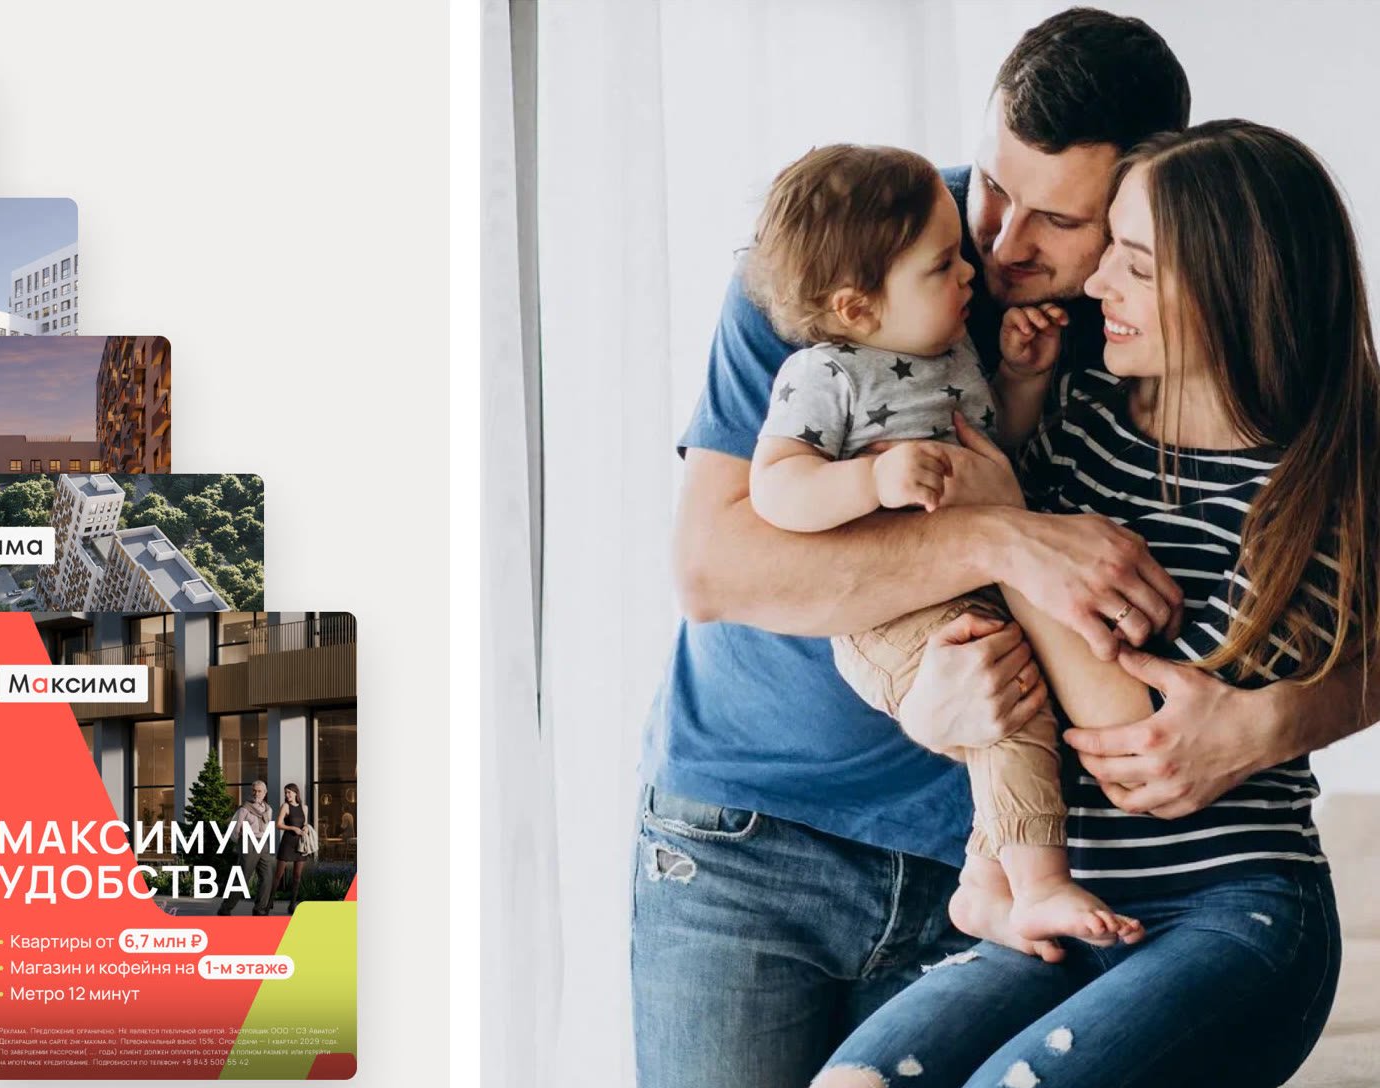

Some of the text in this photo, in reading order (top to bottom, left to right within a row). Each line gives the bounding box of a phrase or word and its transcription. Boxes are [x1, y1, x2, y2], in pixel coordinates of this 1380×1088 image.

[9, 674, 136, 694] Максима
[0, 820, 276, 855] МАКСИМУМ
[11, 934, 91, 953] Квартиры
[96, 937, 115, 949] от
[124, 934, 149, 950] 6,7
[153, 937, 186, 948] млн
[11, 959, 288, 979] Магазин и кофейня на 1-м этаже
[11, 986, 141, 1004] Метро 12 минут
